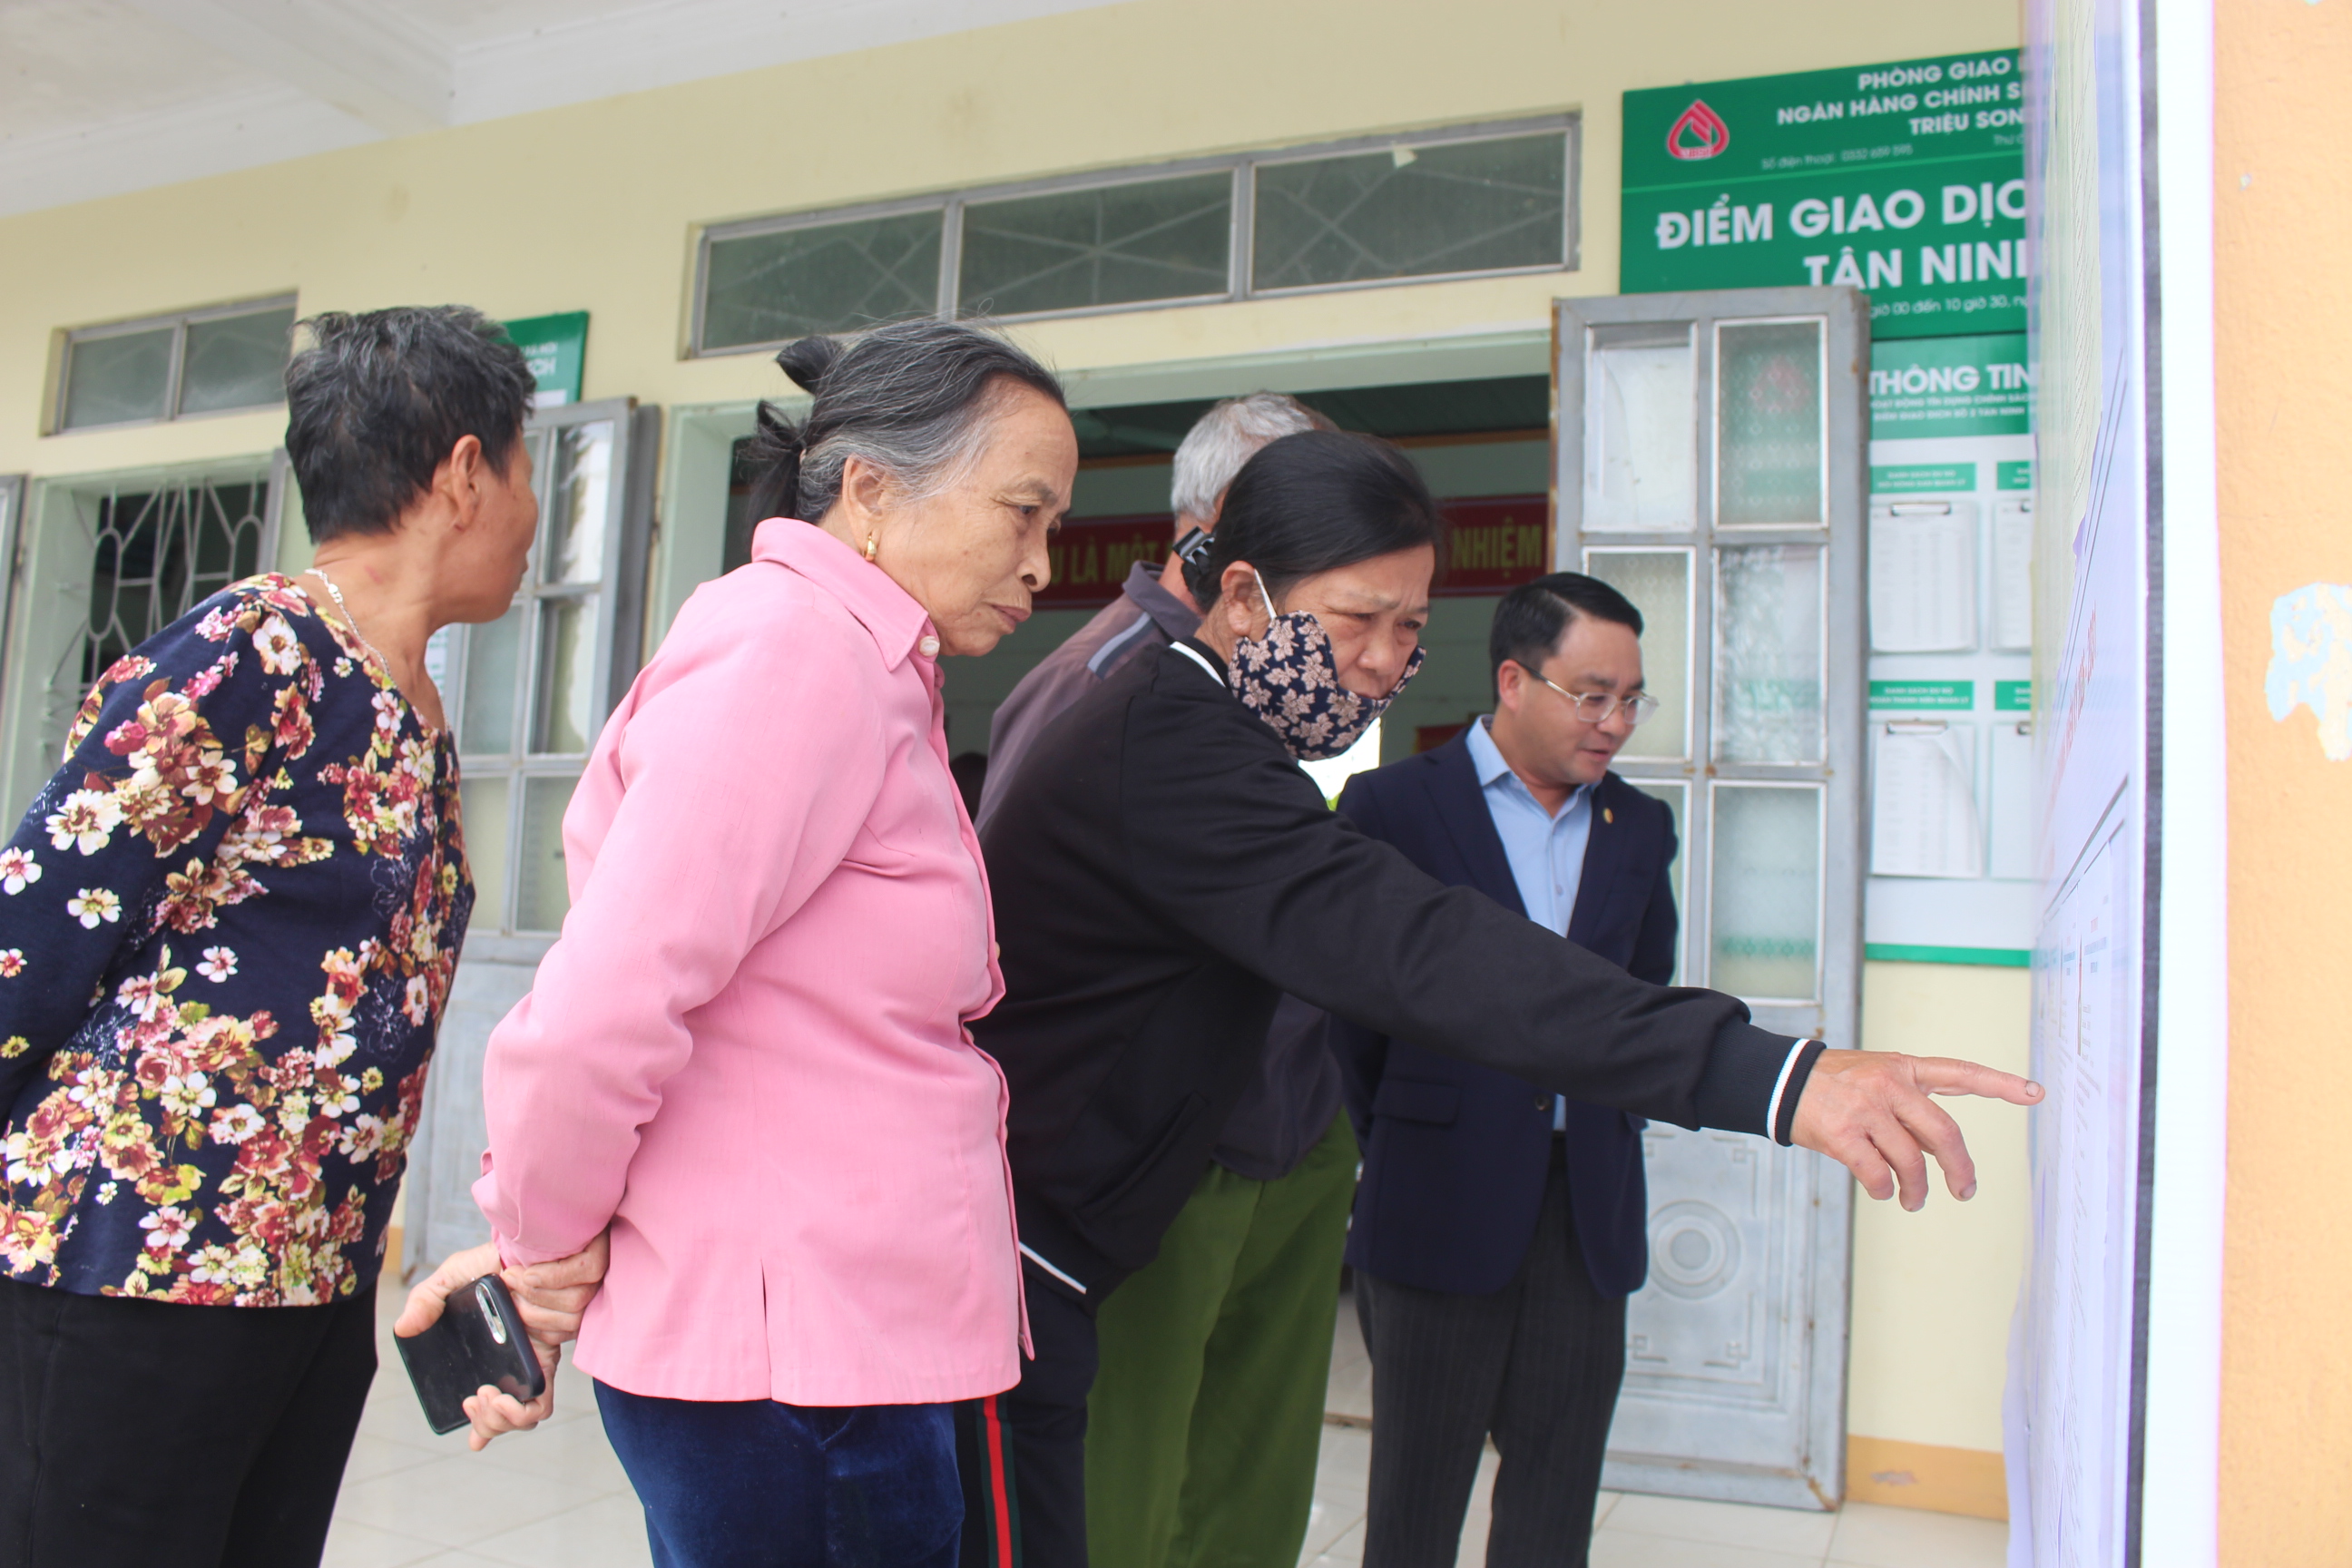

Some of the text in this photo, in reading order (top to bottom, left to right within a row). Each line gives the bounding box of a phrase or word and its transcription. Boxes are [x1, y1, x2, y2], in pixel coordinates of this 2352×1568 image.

[1857, 65, 1943, 91] PHÒNG
[1948, 57, 2012, 80] GIAO
[1777, 101, 1844, 125] NGÂN
[1849, 93, 1919, 117] HÀNG
[1924, 83, 2001, 109] CHÍNH
[1908, 112, 1970, 135] TRIỆU
[1655, 178, 2027, 250] ĐIỂM GIAO DỊC
[1803, 245, 1903, 291] TÂN
[1869, 362, 2031, 396] THÔNG TIN
[1451, 514, 1542, 580] NHIỆM
